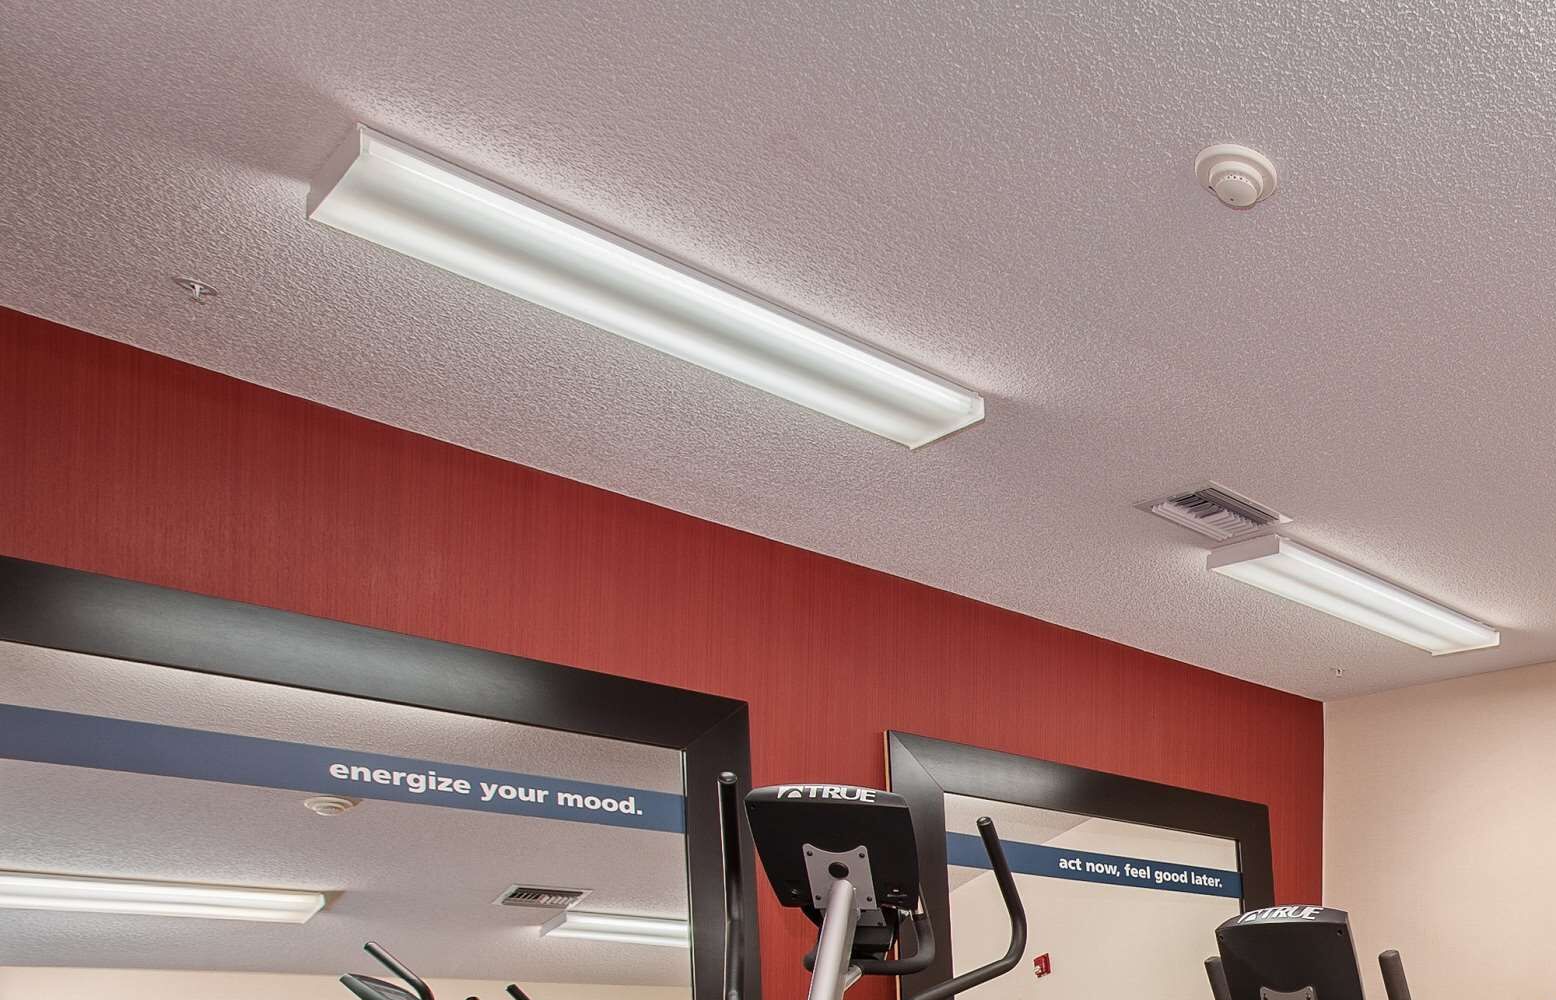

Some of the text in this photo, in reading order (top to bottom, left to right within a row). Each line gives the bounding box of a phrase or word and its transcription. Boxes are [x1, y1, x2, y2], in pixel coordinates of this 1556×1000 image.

[329, 762, 643, 815] energize your mood.
[804, 785, 877, 802] TRUE
[1059, 857, 1223, 888] act now, feel good later.
[1261, 905, 1324, 920] TRUE
